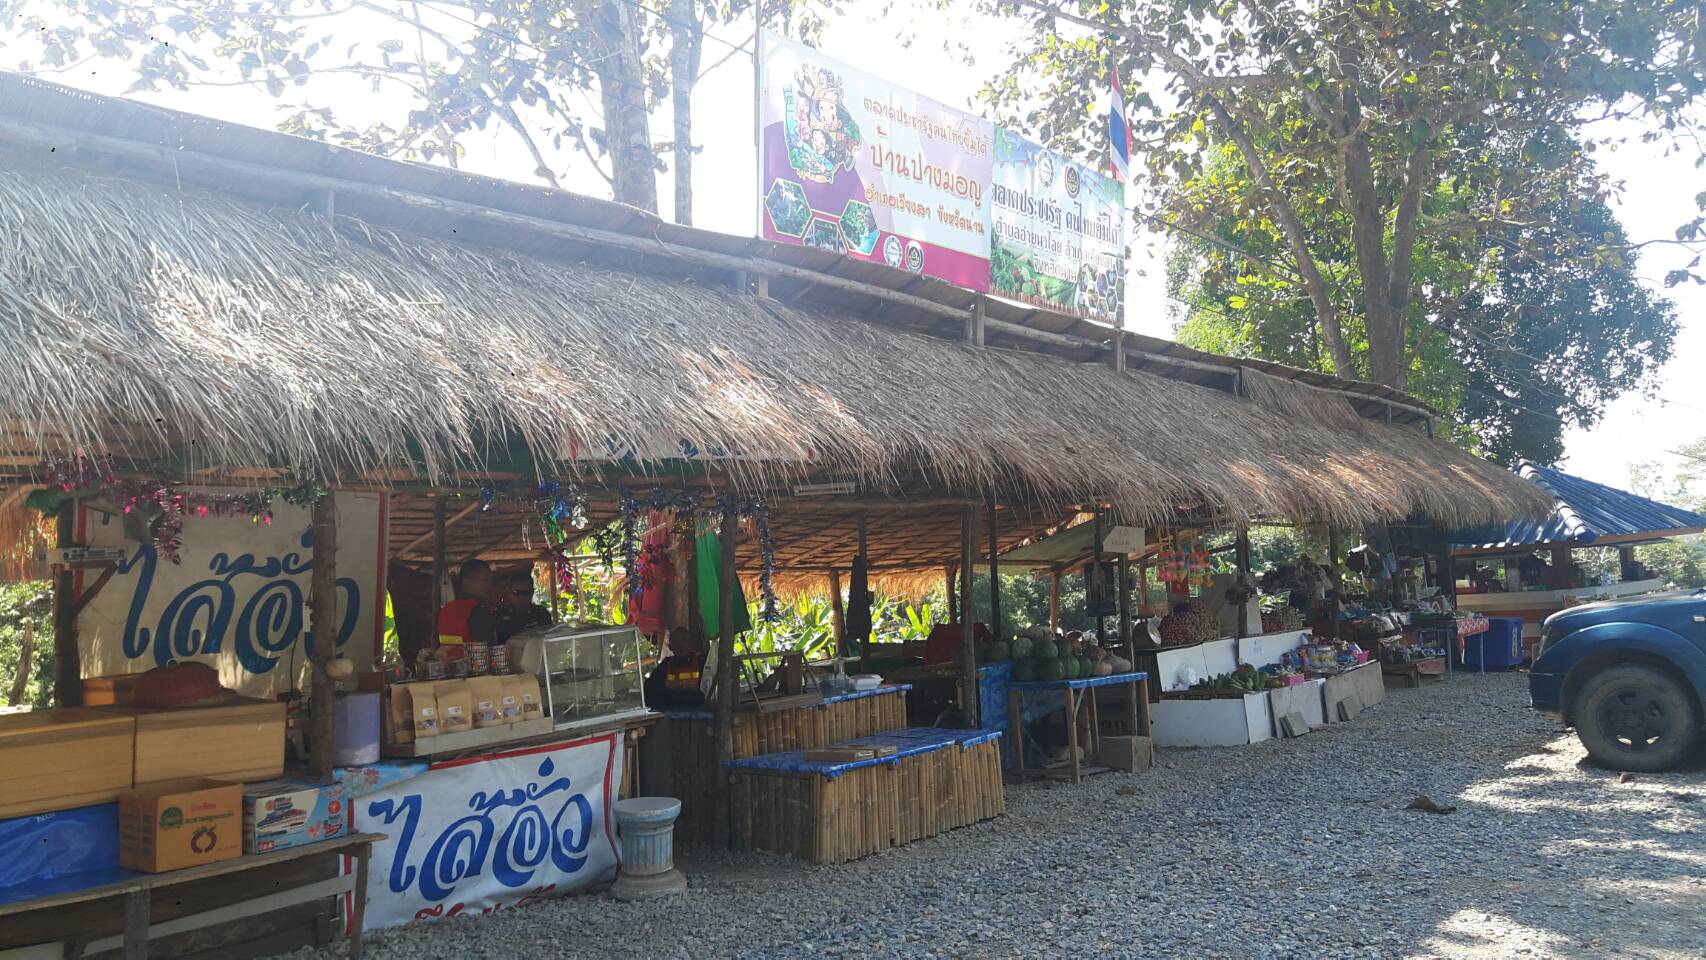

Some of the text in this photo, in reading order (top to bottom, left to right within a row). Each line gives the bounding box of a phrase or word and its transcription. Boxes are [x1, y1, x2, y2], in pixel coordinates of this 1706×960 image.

[870, 126, 982, 208] บ้านปางมอญ
[937, 205, 985, 236] จังหวัดน่าน
[368, 756, 593, 901] ไส้อั่ว
